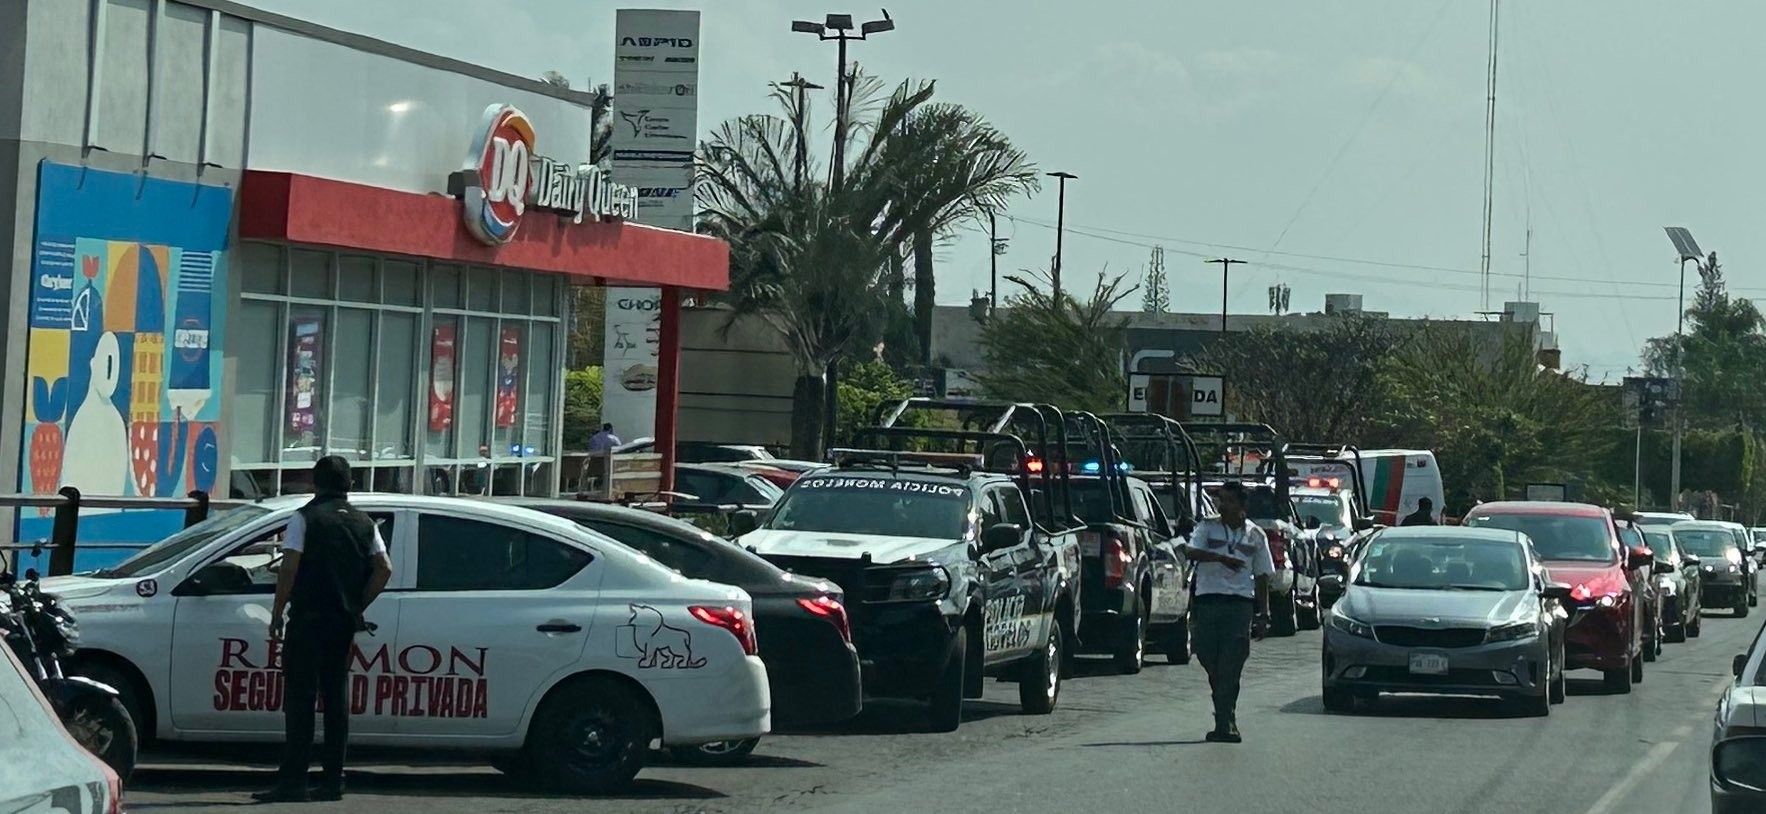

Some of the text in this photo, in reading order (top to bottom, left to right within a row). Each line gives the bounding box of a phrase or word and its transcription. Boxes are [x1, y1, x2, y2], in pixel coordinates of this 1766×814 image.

[488, 136, 528, 216] DQ
[537, 158, 639, 224] Dairy Queen
[213, 669, 488, 718] SEGUD PRIVADA
